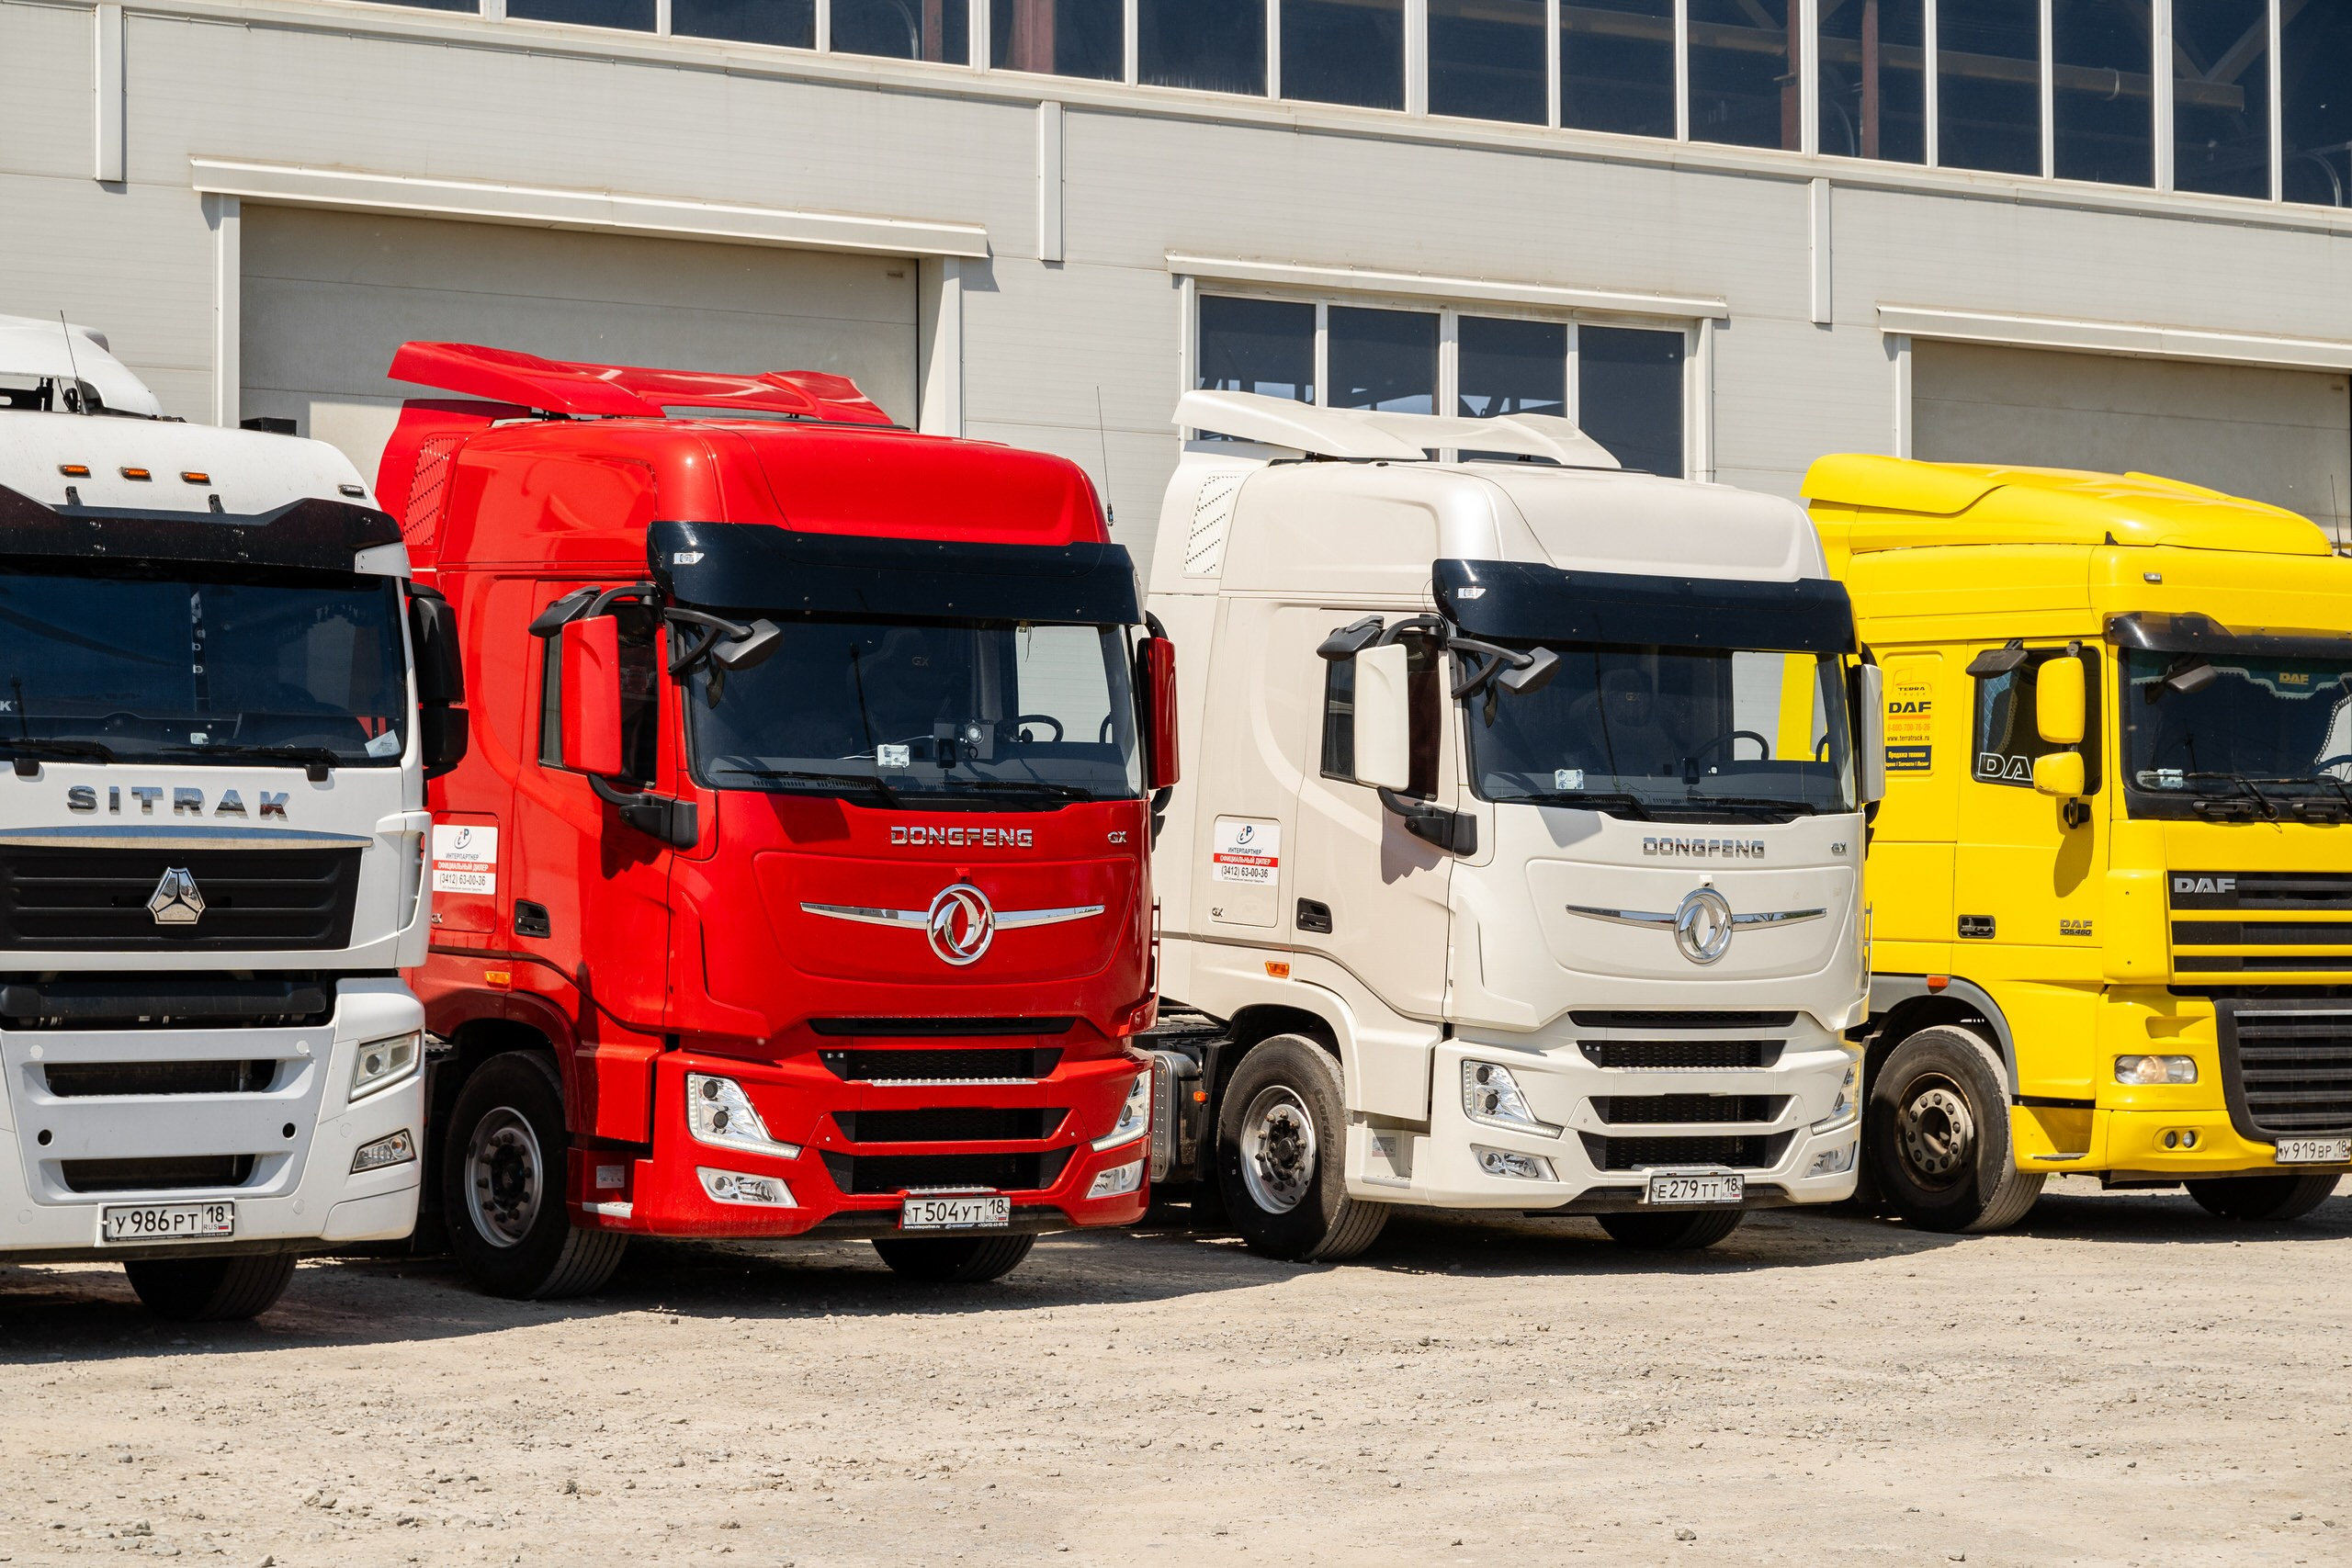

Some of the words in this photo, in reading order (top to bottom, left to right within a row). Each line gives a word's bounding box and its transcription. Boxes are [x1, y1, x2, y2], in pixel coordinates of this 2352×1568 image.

[2279, 672, 2309, 683] DAF
[1889, 701, 1931, 713] DAF
[1978, 752, 2039, 781] DA
[67, 785, 290, 818] SITRAK
[891, 826, 1033, 847] DONGFENG
[1107, 830, 1127, 843] GX
[1228, 847, 1261, 855] ИНТЕРПАРТНЕР
[1643, 837, 1765, 857] DONGFENG
[1831, 842, 1847, 854] GX
[437, 861, 472, 871] ОФИЦИАЛЬНЫЙ
[473, 863, 489, 872] ДИЛЕР
[1219, 854, 1255, 864] ОФИЦИАЛЬНЫЙ
[1255, 858, 1271, 866] ДИЛЕР
[1221, 865, 1239, 878] (3412)
[1241, 867, 1268, 878] 63-00-36
[440, 873, 458, 886] (3412)
[459, 874, 486, 886] 63-00-36
[2174, 877, 2235, 894] DAF
[2060, 919, 2092, 928] DAF
[2336, 1140, 2346, 1153] 18
[1724, 1178, 1737, 1191] 18
[989, 1199, 1004, 1214] 18
[206, 1206, 224, 1223] 18
